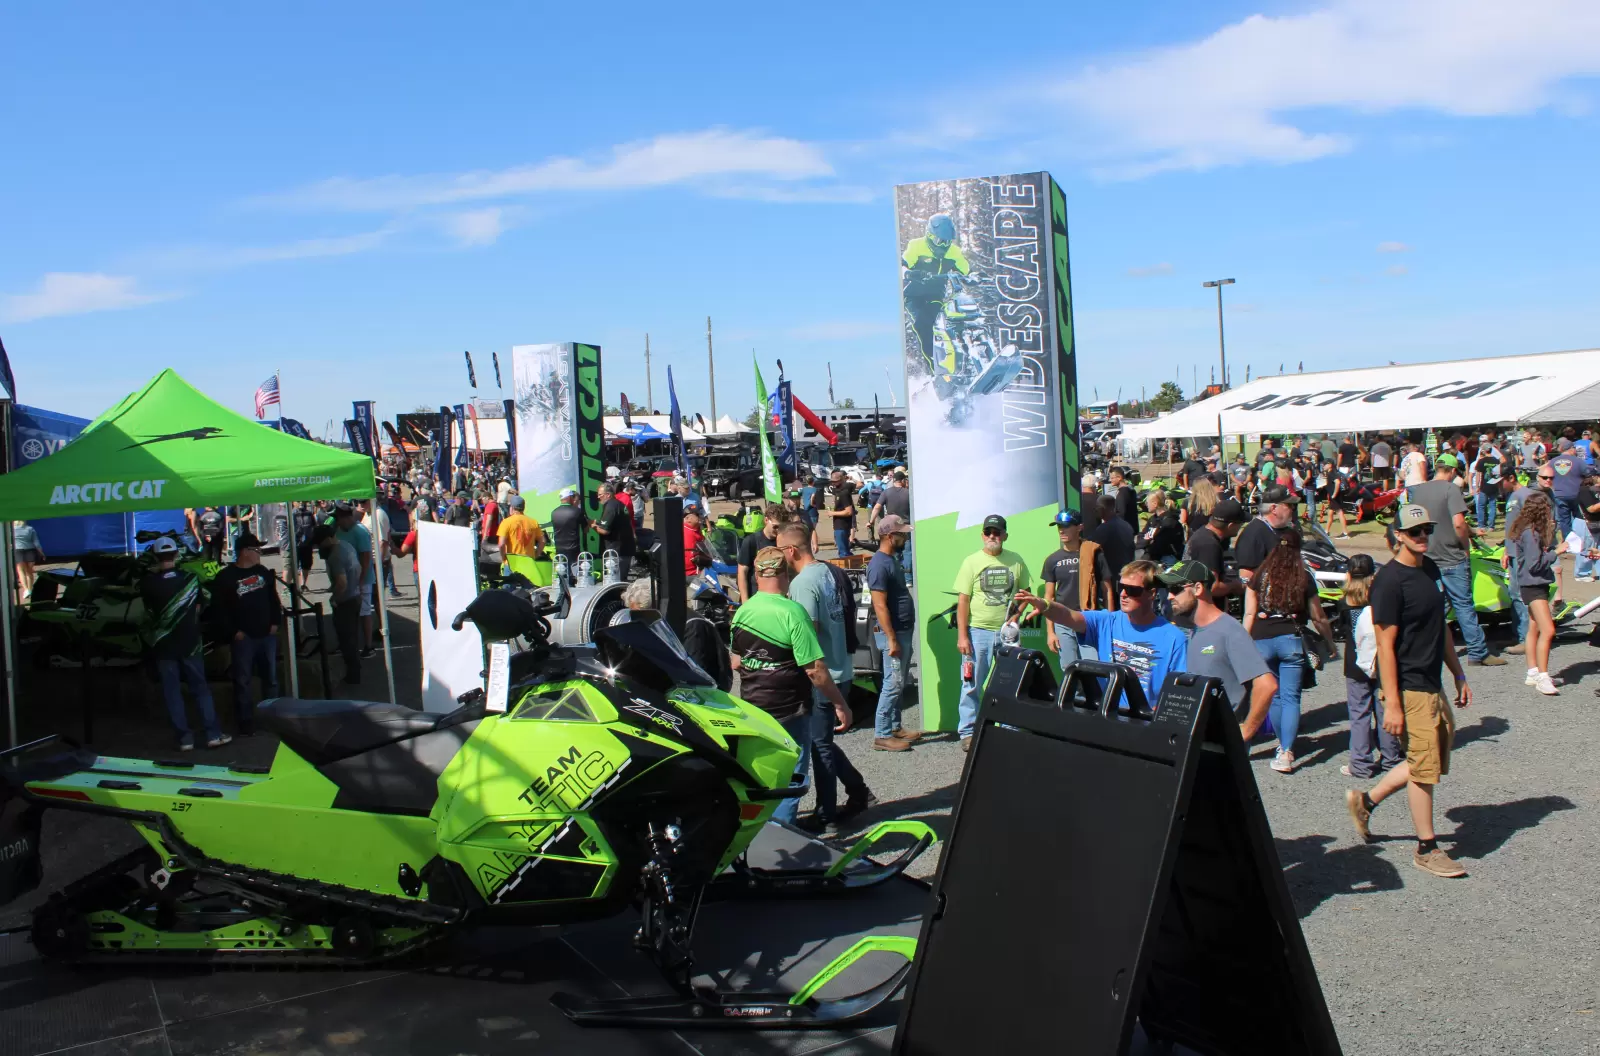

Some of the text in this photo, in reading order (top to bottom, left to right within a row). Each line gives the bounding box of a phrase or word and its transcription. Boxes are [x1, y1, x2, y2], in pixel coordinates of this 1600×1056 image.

[991, 184, 1048, 452] WIDESCAPE
[557, 345, 573, 461] CATALYST
[1223, 385, 1418, 411] ARCTIC
[1408, 375, 1541, 400] CAT
[49, 479, 166, 505] ARCTIC CAT
[254, 475, 331, 487] ARCTICCAT.COM
[1056, 557, 1080, 567] STRO
[517, 745, 582, 805] TEAM
[171, 802, 193, 812] 137
